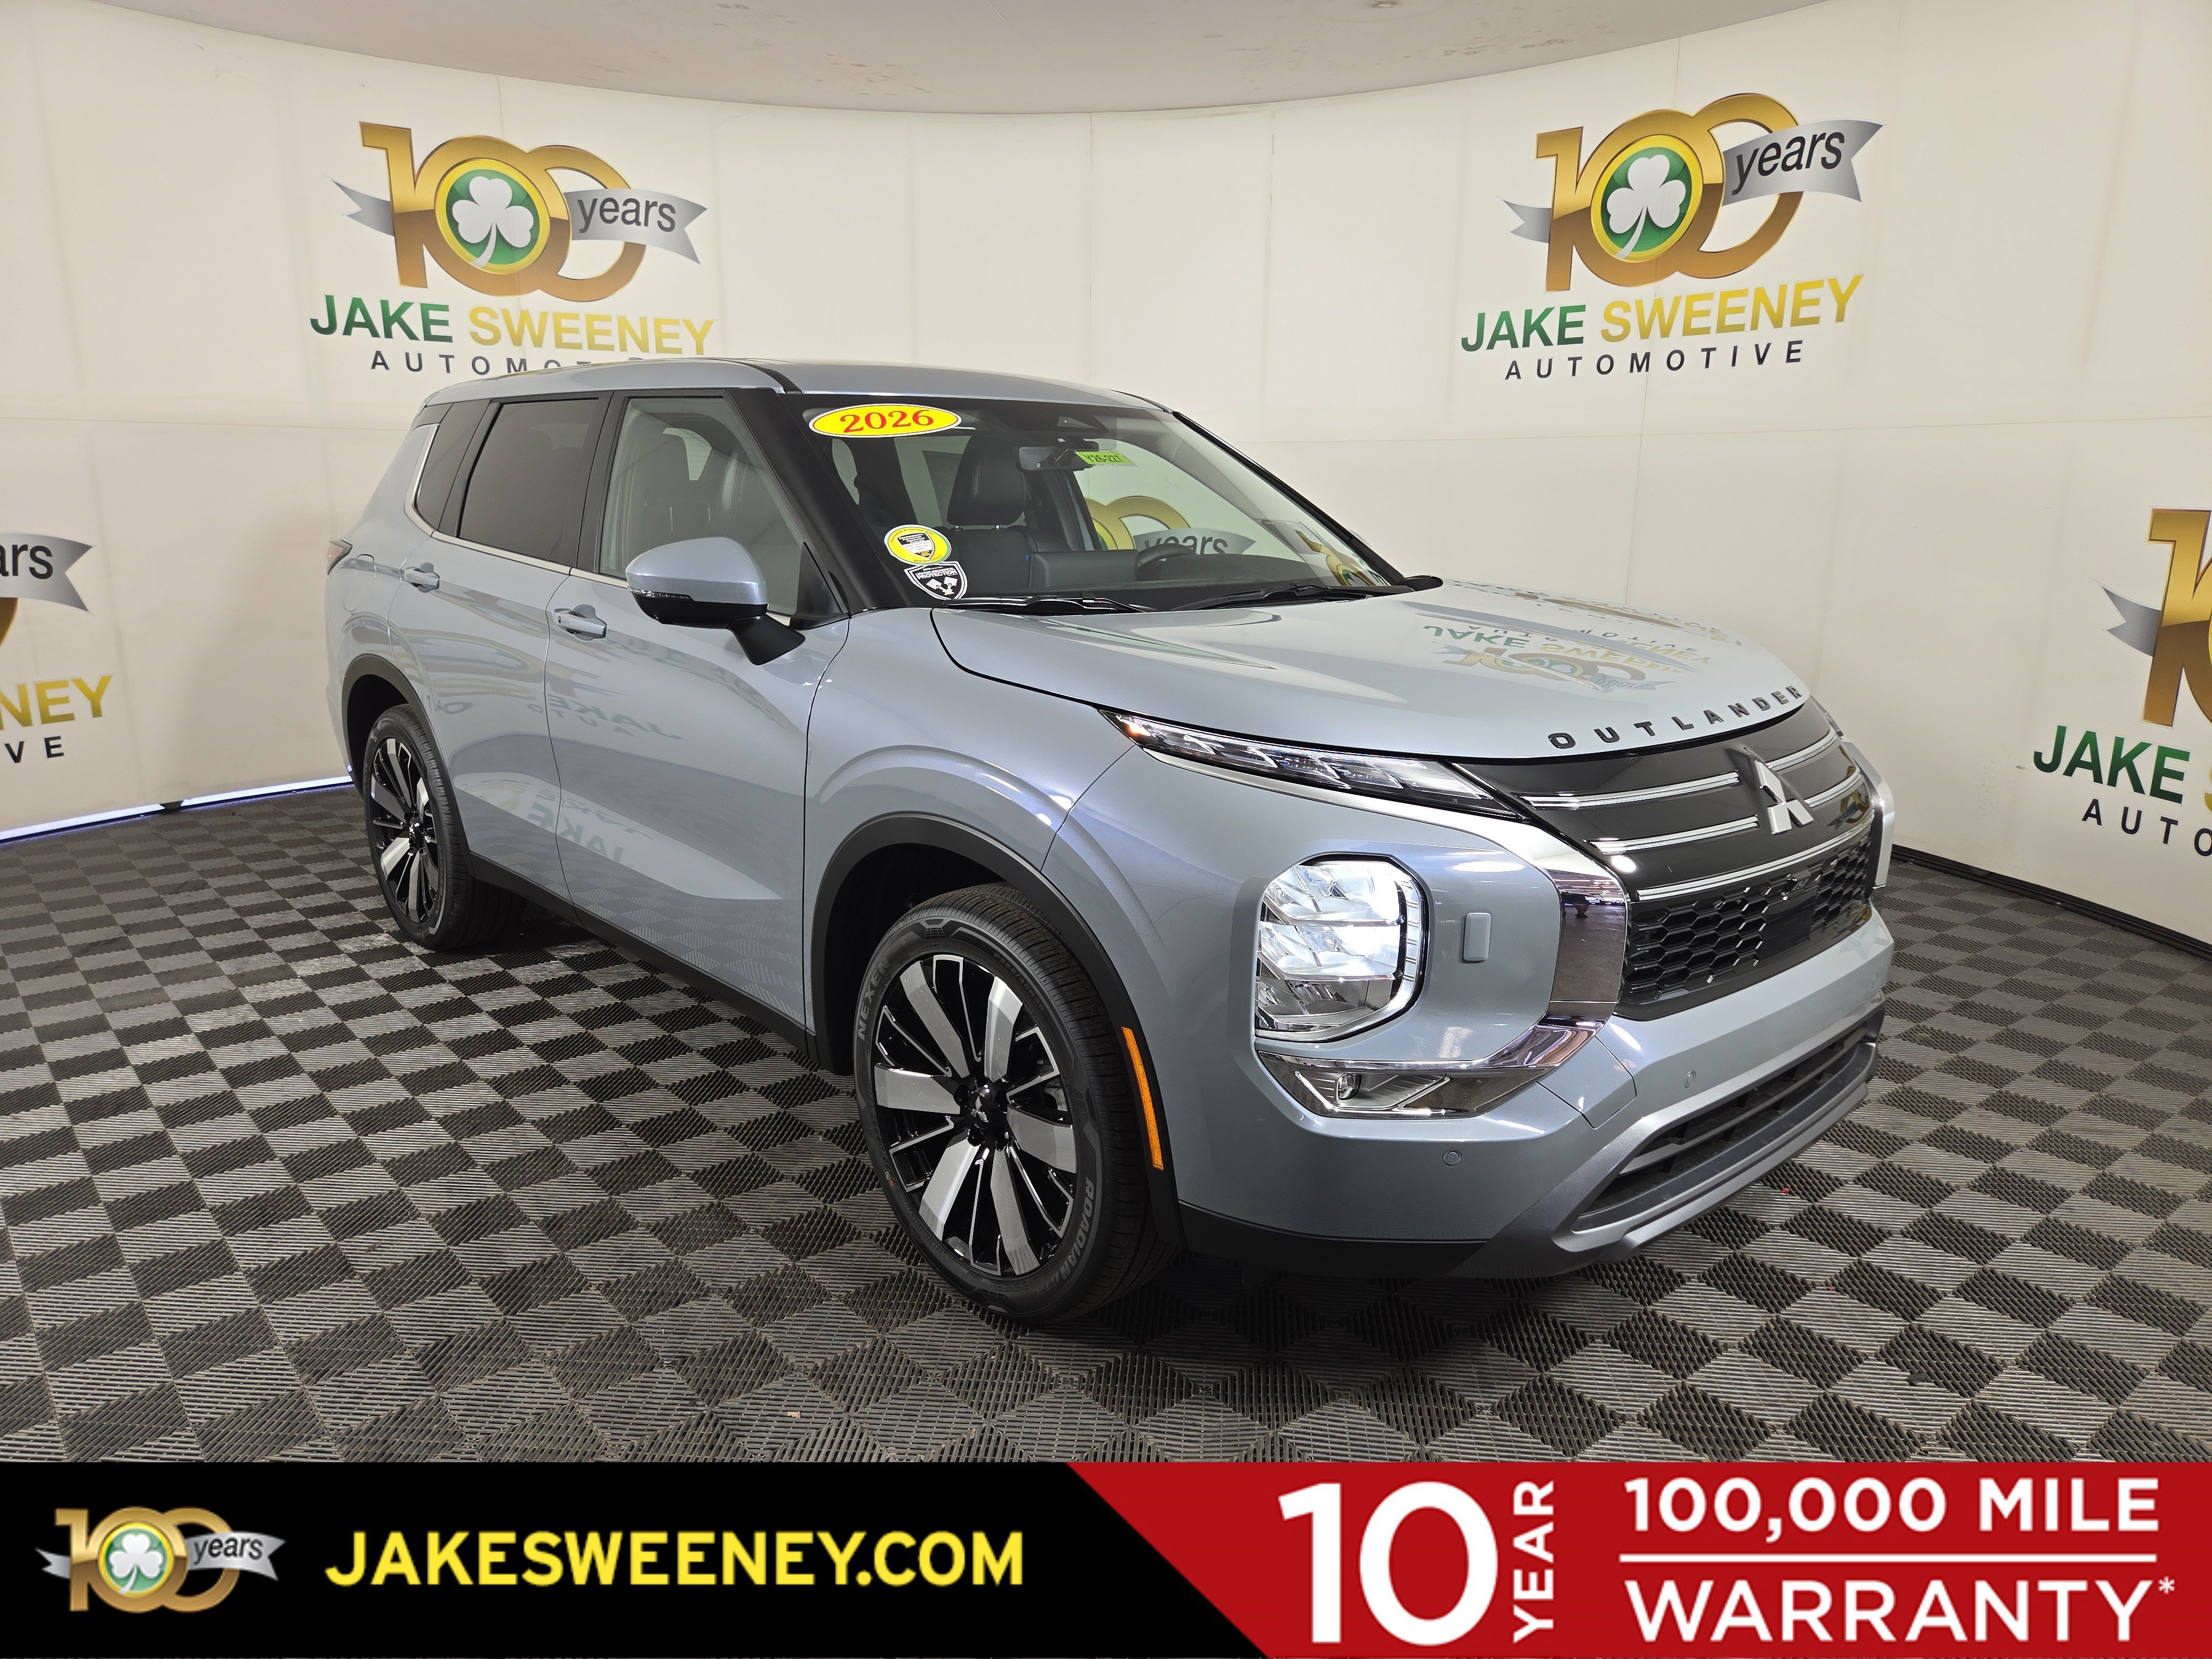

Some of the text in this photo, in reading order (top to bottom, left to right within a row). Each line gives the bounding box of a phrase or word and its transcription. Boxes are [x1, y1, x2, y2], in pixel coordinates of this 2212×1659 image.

[1535, 92, 1804, 292] 100
[1732, 132, 1844, 196] years
[359, 121, 646, 302] 100
[577, 197, 677, 234] years
[310, 294, 715, 356] JAKE SWEENEY
[1461, 275, 1864, 352] JAKE SWEENEY
[1504, 340, 1804, 380] AUTOMOTIVE
[840, 409, 934, 433] 2026
[1082, 454, 1123, 462] Y26-227
[917, 569, 959, 580] PROTECTION
[1548, 685, 1803, 749] OUTLANDER
[2034, 725, 2191, 805] JAKE
[858, 955, 891, 1040] NEXEN
[1060, 1177, 1094, 1281] ROADIAN
